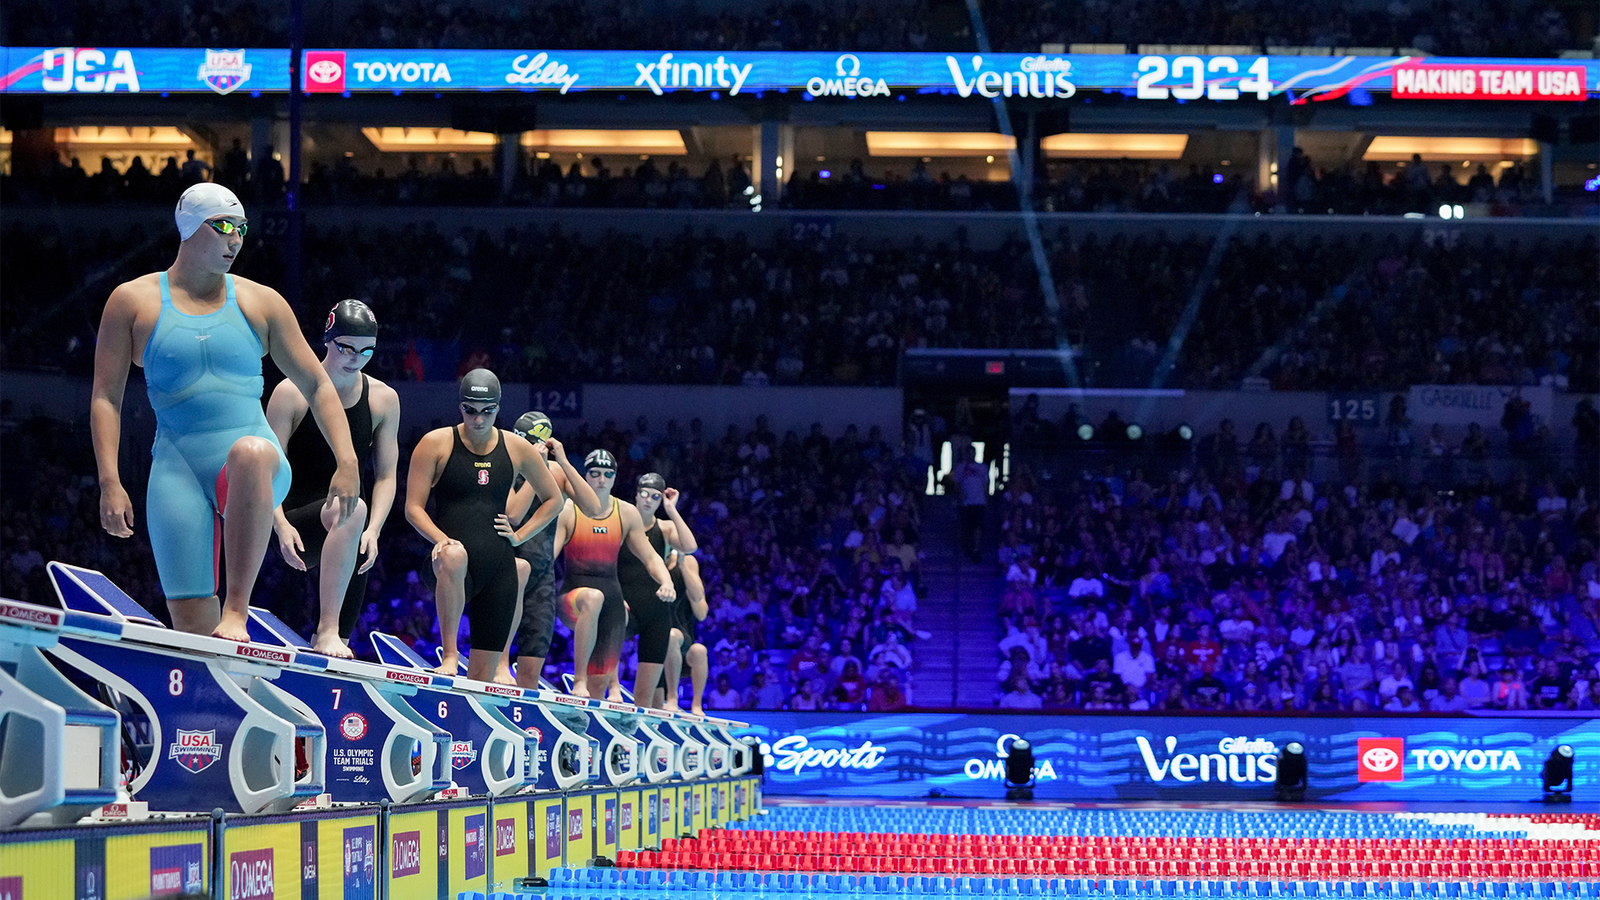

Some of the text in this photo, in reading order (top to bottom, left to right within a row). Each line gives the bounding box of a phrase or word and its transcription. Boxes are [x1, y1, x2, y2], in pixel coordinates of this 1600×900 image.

[42, 49, 140, 93] USA
[353, 62, 452, 83] TOYOTA
[505, 52, 579, 94] Lilly
[634, 53, 753, 96] xfinity
[1020, 55, 1072, 73] Gillette
[806, 77, 891, 97] OMEGA
[946, 55, 1076, 98] Venus
[1136, 56, 1274, 100] 2024
[1396, 69, 1580, 96] MAKING TEAM USA
[533, 390, 577, 411] 124
[1330, 399, 1375, 420] 125
[10, 607, 53, 624] OMEGA
[252, 649, 285, 661] OMEGA
[169, 669, 183, 696] 8
[398, 673, 425, 684] OMEGA
[331, 689, 342, 710] 7
[494, 687, 518, 696] OMEGA
[438, 701, 448, 719] 6
[513, 706, 522, 722] 5
[174, 746, 217, 754] SWIMMING
[181, 735, 210, 747] USA
[1219, 736, 1275, 754] Gillette
[333, 749, 374, 757] U.S. OLYMPIC
[772, 735, 887, 776] Sports
[1136, 736, 1277, 782] Venus
[1411, 749, 1522, 771] TOYOTA
[964, 759, 1057, 779] OMA
[399, 839, 420, 870] OMEGA
[241, 859, 274, 899] OMEGA
